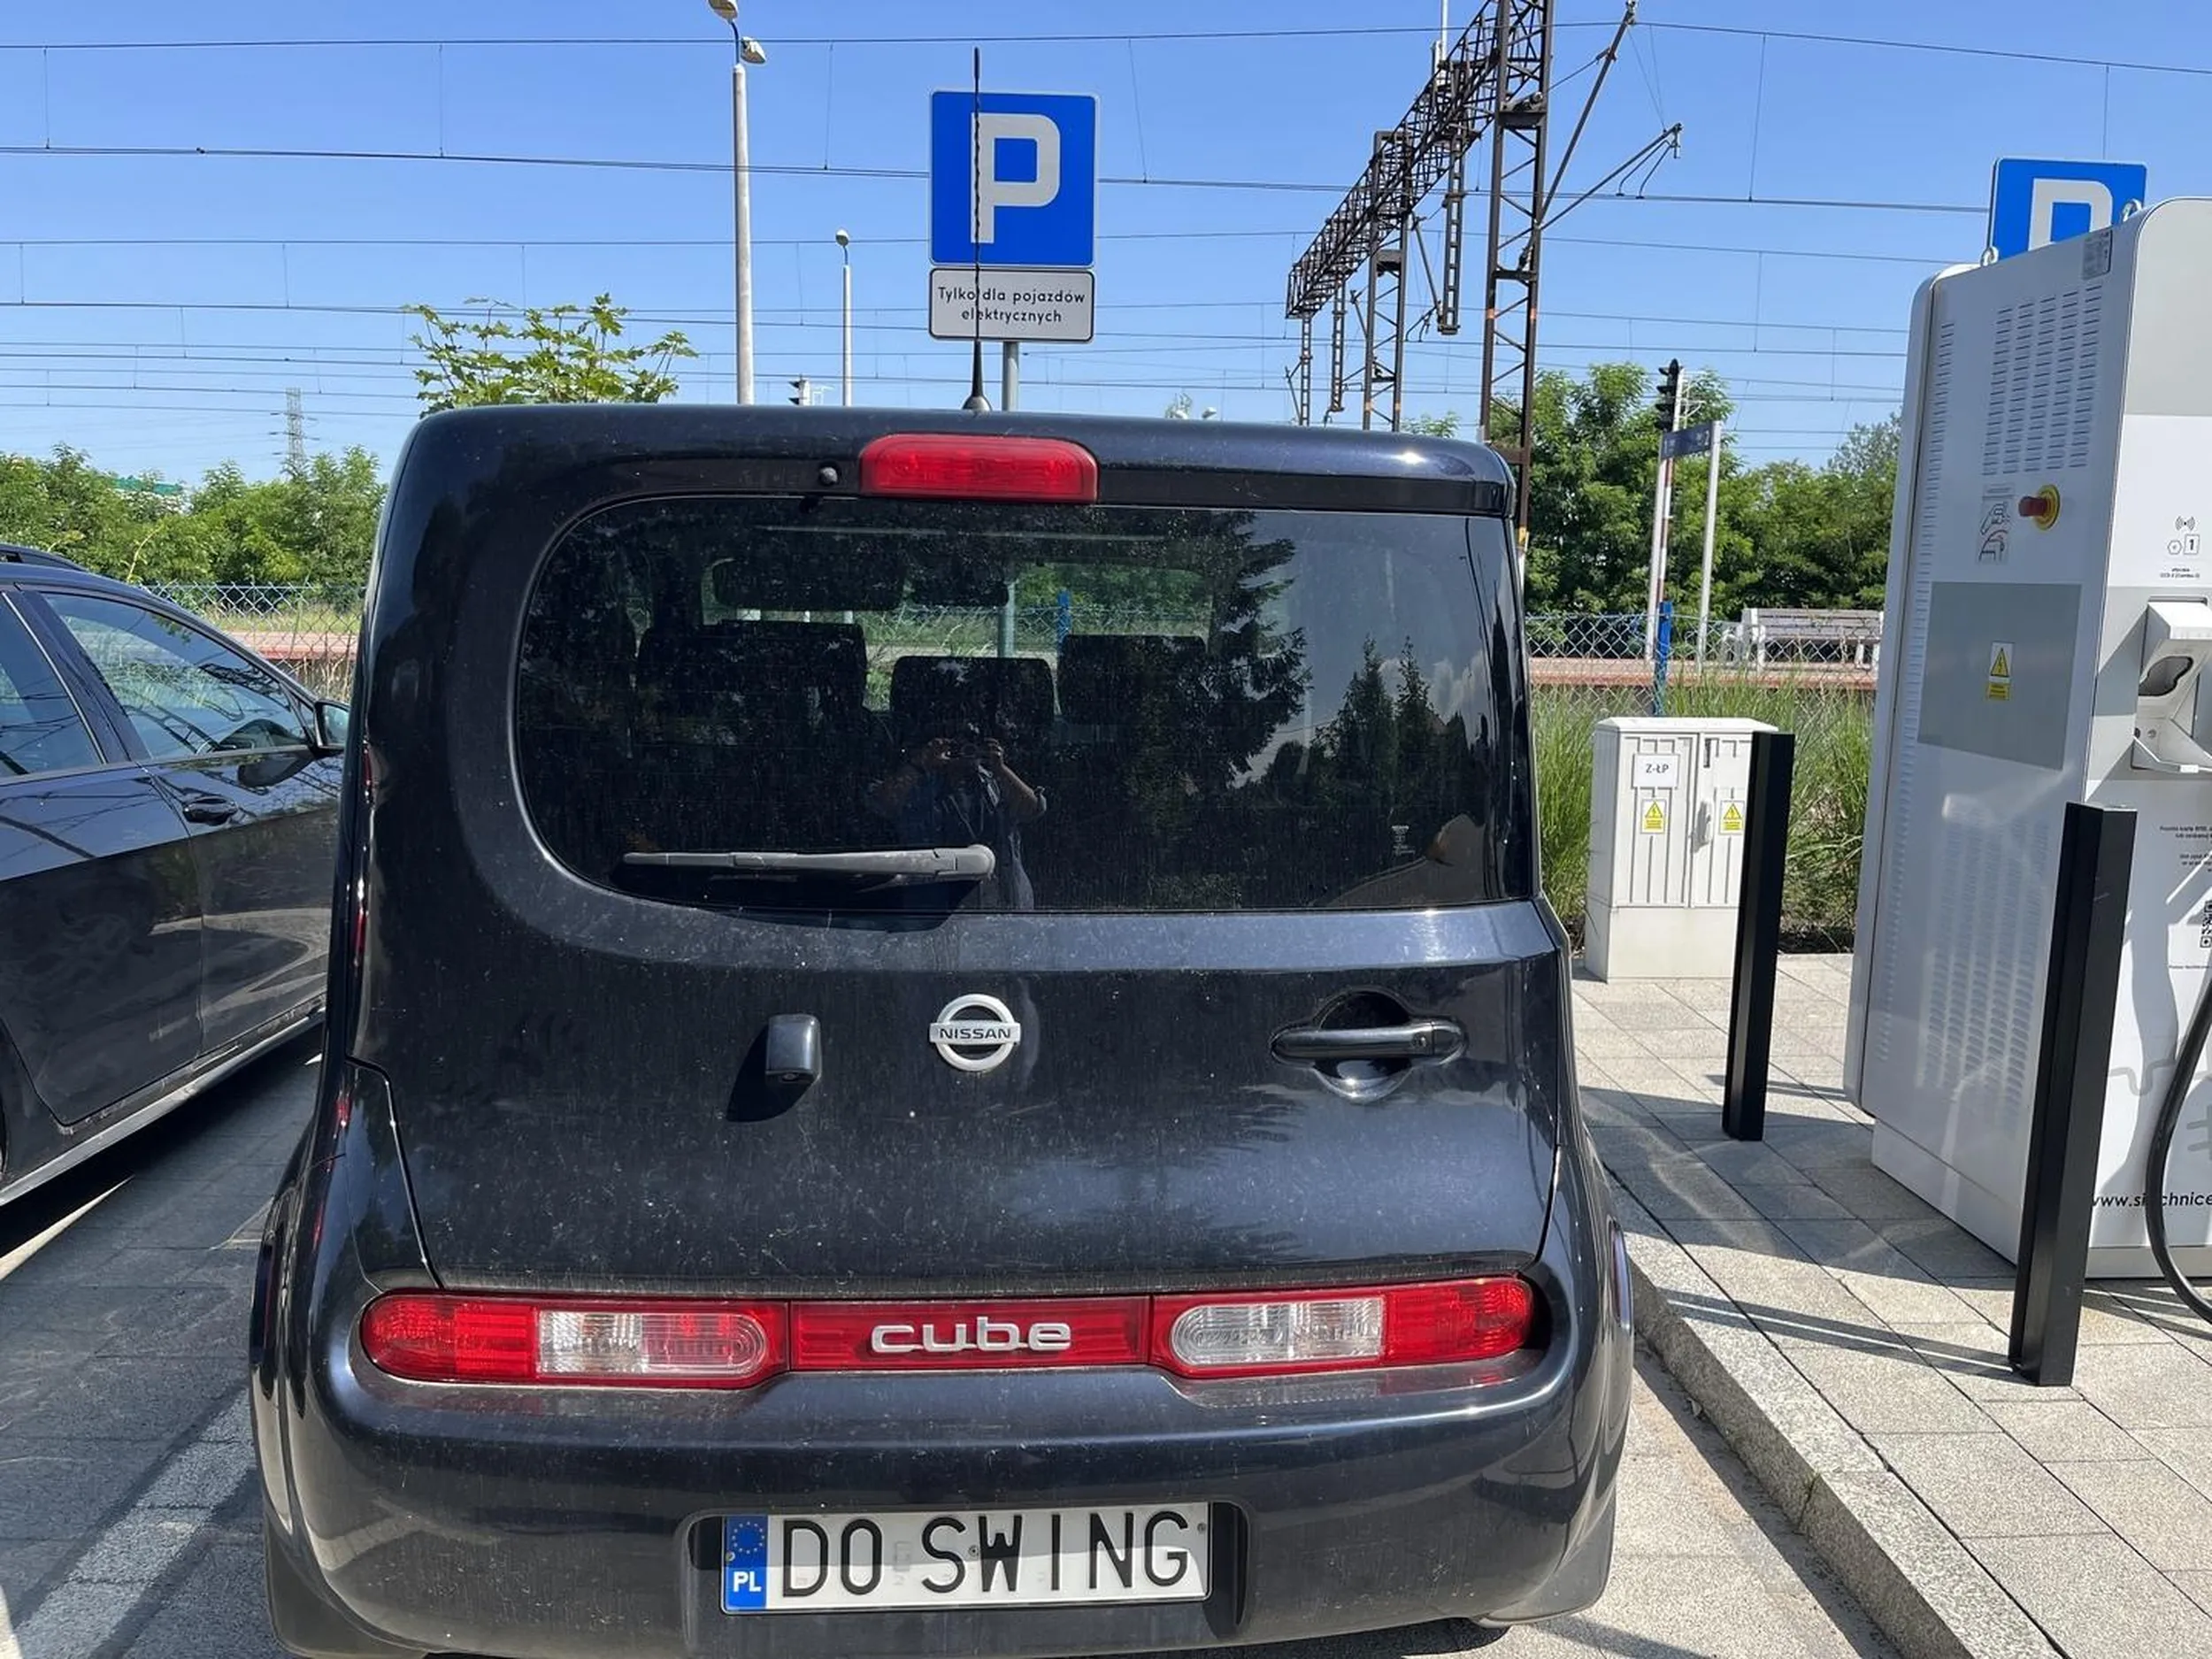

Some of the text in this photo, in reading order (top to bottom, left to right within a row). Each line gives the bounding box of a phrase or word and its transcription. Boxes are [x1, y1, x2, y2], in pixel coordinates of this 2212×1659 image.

[970, 112, 1061, 244] P
[938, 286, 1086, 305] Tylko dla pojazdów
[961, 307, 1062, 326] elektrycznych
[940, 1028, 1010, 1040] NISSAN
[871, 1316, 1071, 1353] cube
[921, 1510, 1189, 1594] SWING
[733, 1571, 762, 1593] PL
